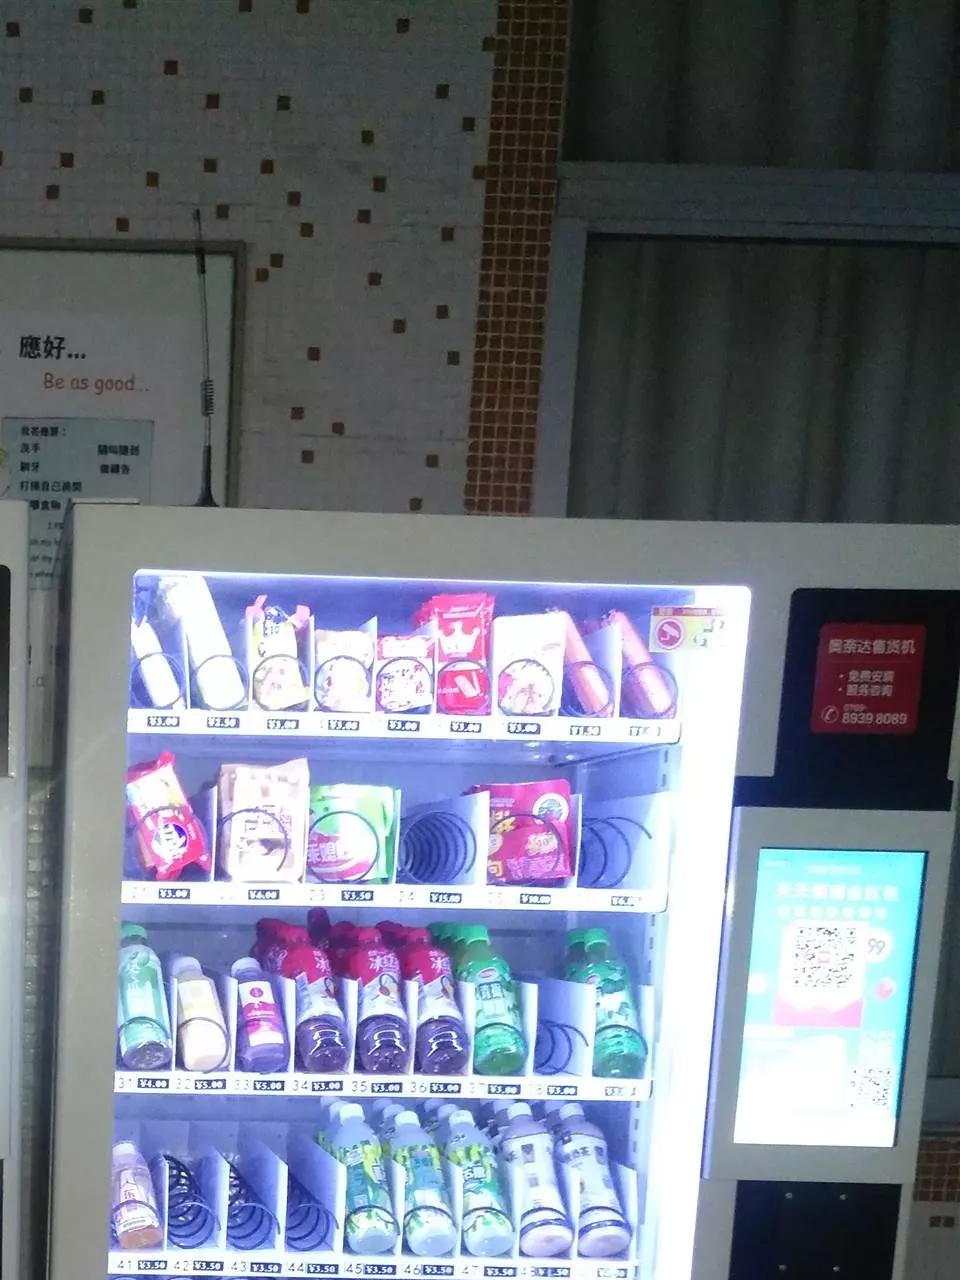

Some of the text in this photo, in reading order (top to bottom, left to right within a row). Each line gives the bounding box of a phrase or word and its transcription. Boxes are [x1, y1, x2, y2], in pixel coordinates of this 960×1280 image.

[43, 374, 65, 390] Be
[70, 376, 88, 390] as
[842, 713, 908, 725] 8939 8089
[139, 1079, 167, 1088] ¥4.00
[196, 1080, 223, 1089] ¥5.00
[254, 1081, 282, 1090] ¥5.00
[313, 1081, 341, 1090] ¥3.00
[372, 1083, 401, 1091] ¥3.00
[411, 1083, 459, 1093] 36 ¥3.00
[490, 1085, 518, 1093] ¥3.00
[549, 1086, 576, 1094] ¥3.00
[139, 1261, 167, 1270] ¥3.50
[194, 1262, 222, 1270] ¥3.50
[251, 1264, 280, 1272] ¥3.50
[289, 1263, 336, 1273] 44 ¥3.50
[346, 1263, 395, 1274] 45 ¥3.50
[404, 1265, 453, 1275] 46 ¥3.50
[485, 1267, 514, 1276] ¥3.50
